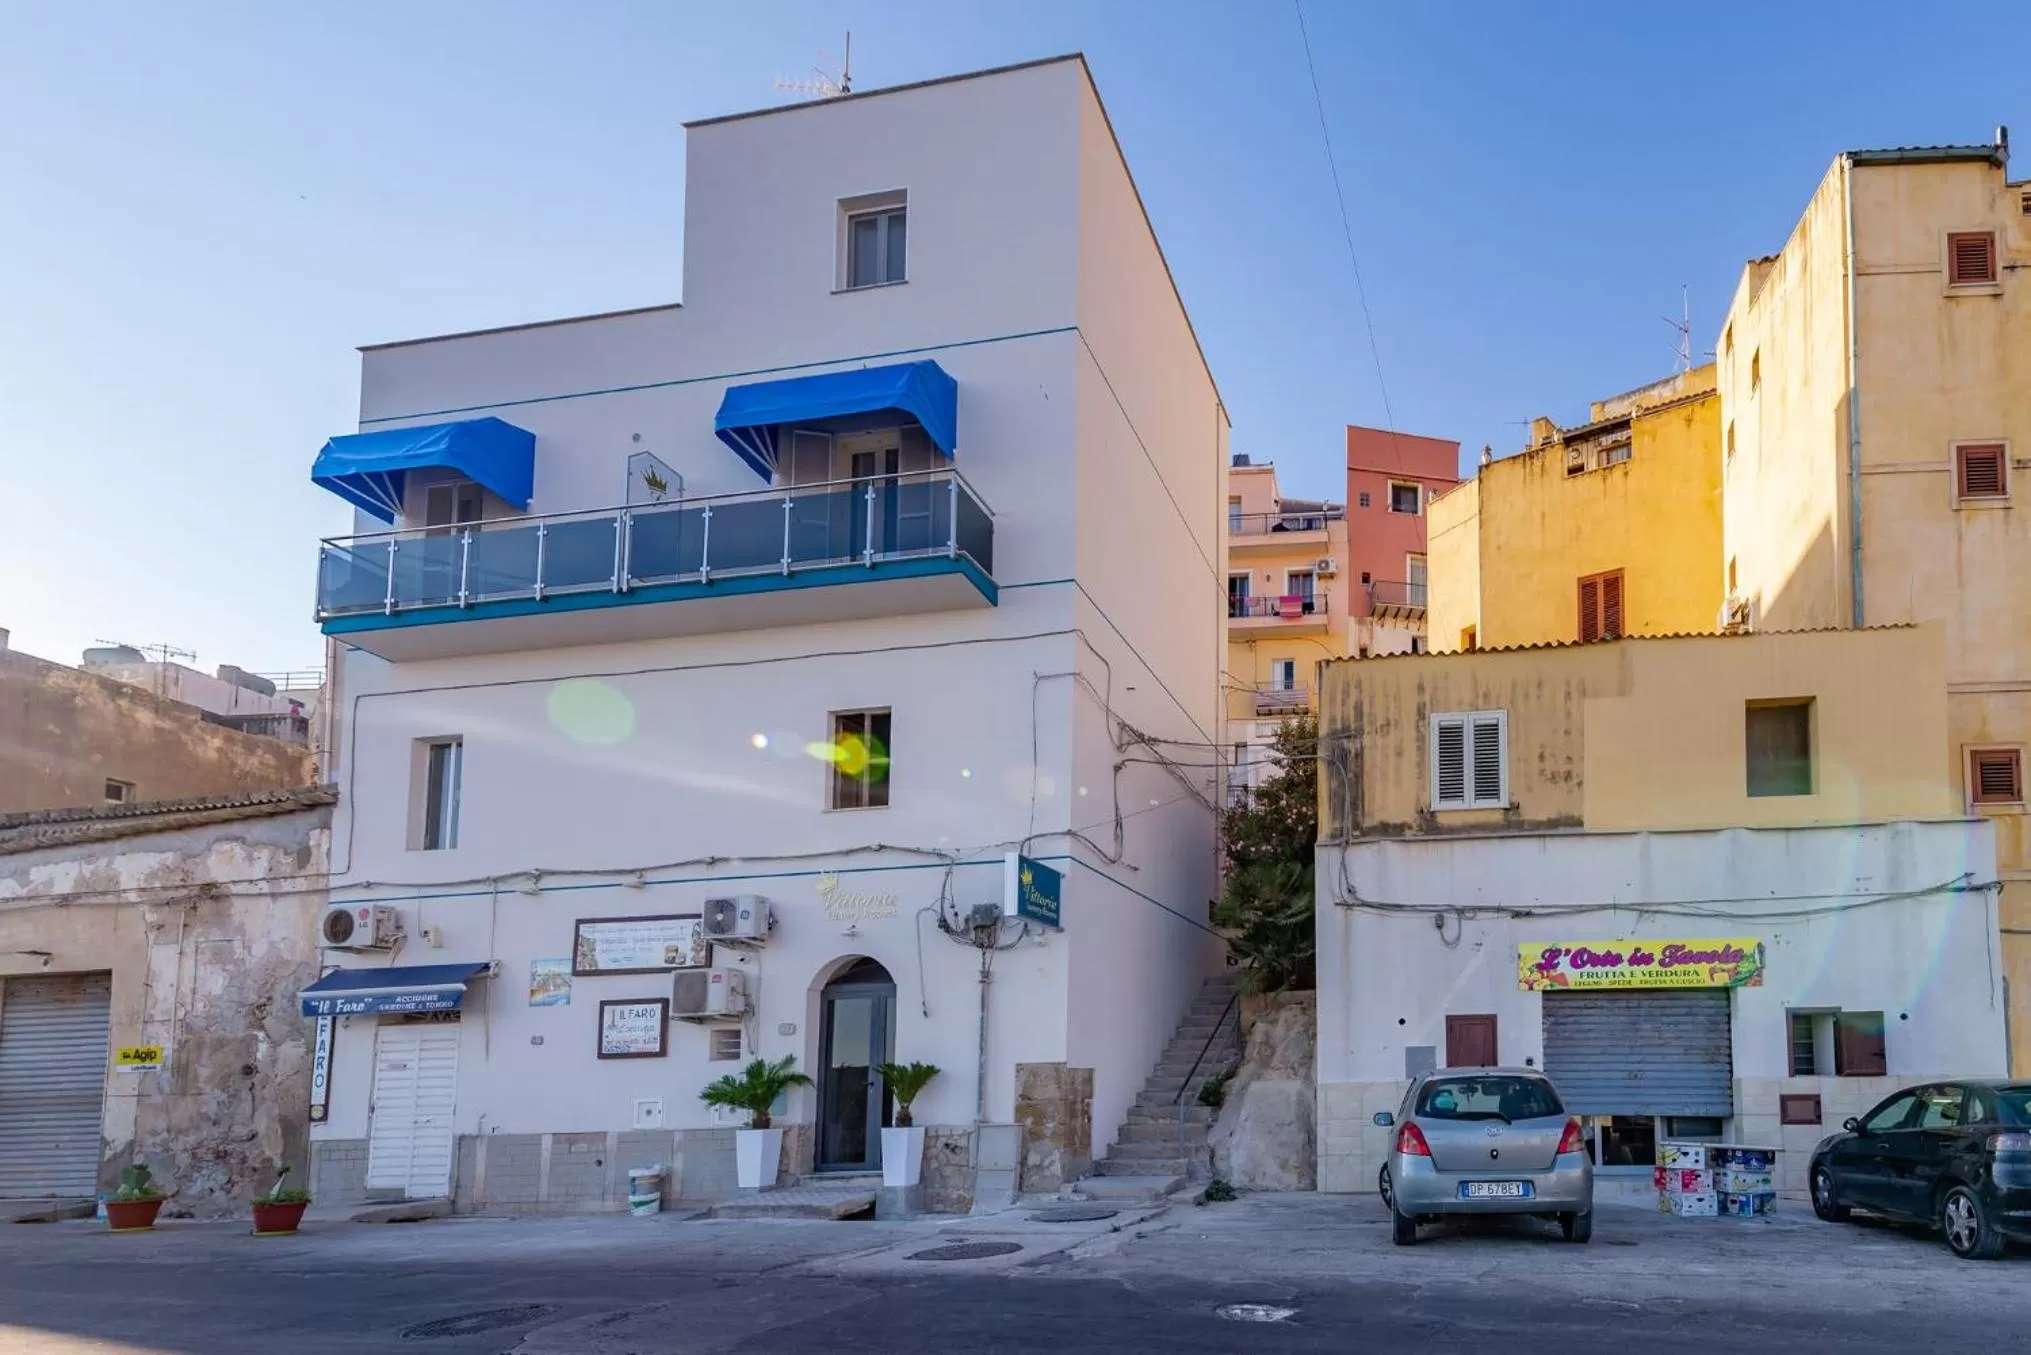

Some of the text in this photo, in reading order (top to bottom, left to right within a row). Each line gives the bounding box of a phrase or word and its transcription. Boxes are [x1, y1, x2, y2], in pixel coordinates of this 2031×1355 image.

[1536, 944, 1744, 970] L'Orto in Tavola
[1580, 968, 1700, 979] FRUTTA E VERDURA
[619, 1007, 656, 1020] IL FARO
[133, 1048, 157, 1063] Agip
[315, 1023, 328, 1088] FARO
[1470, 1183, 1484, 1195] DP
